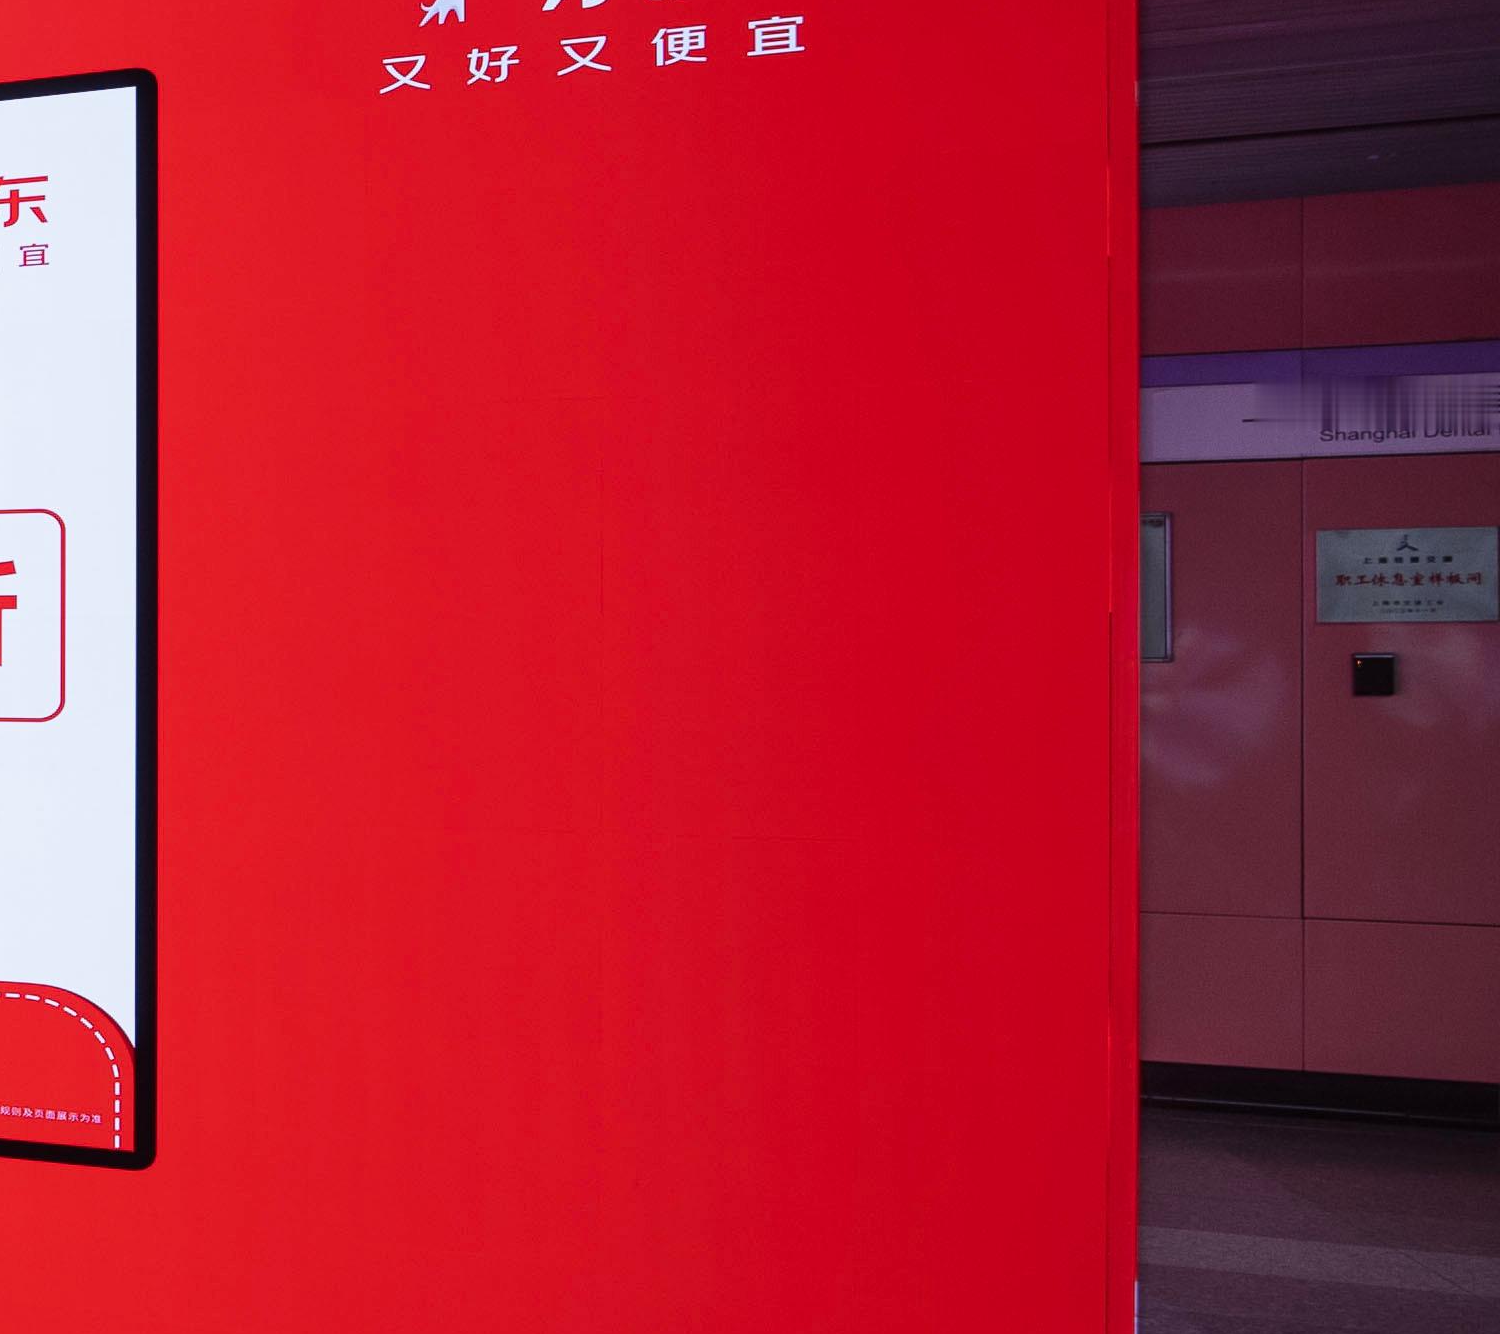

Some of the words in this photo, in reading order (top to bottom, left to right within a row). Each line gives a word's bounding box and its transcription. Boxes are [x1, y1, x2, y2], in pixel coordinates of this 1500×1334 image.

[379, 16, 805, 94] 又好又便宜
